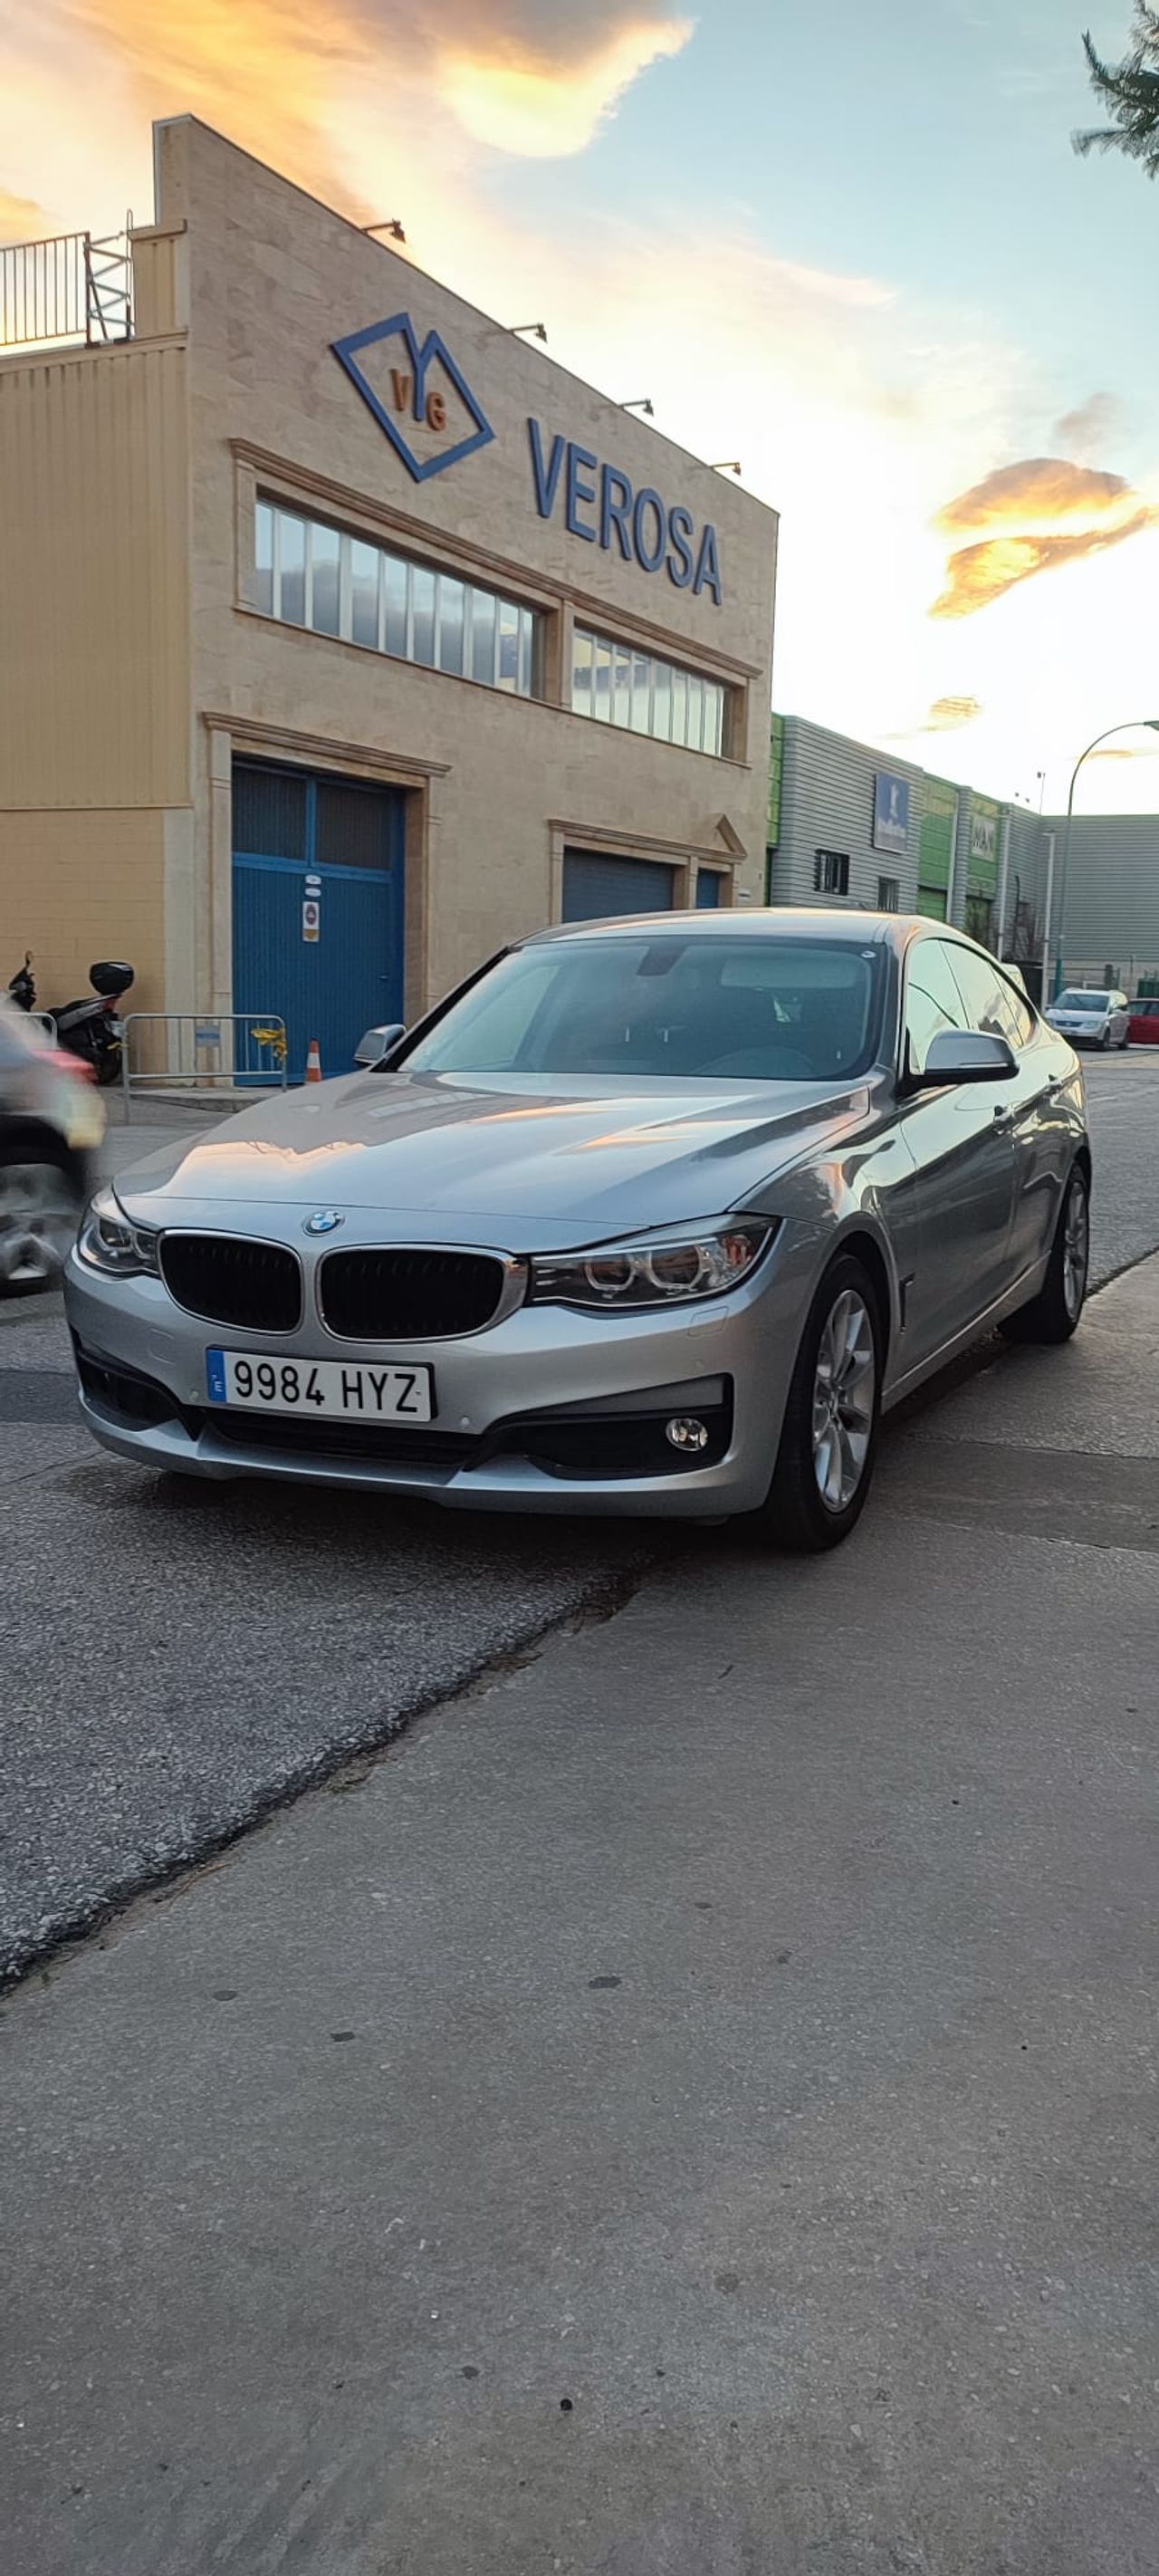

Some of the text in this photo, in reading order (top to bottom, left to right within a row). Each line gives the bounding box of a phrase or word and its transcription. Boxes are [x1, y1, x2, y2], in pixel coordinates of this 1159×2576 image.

[528, 417, 722, 606] VEROSA
[235, 1360, 418, 1414] 9984 HYZ
